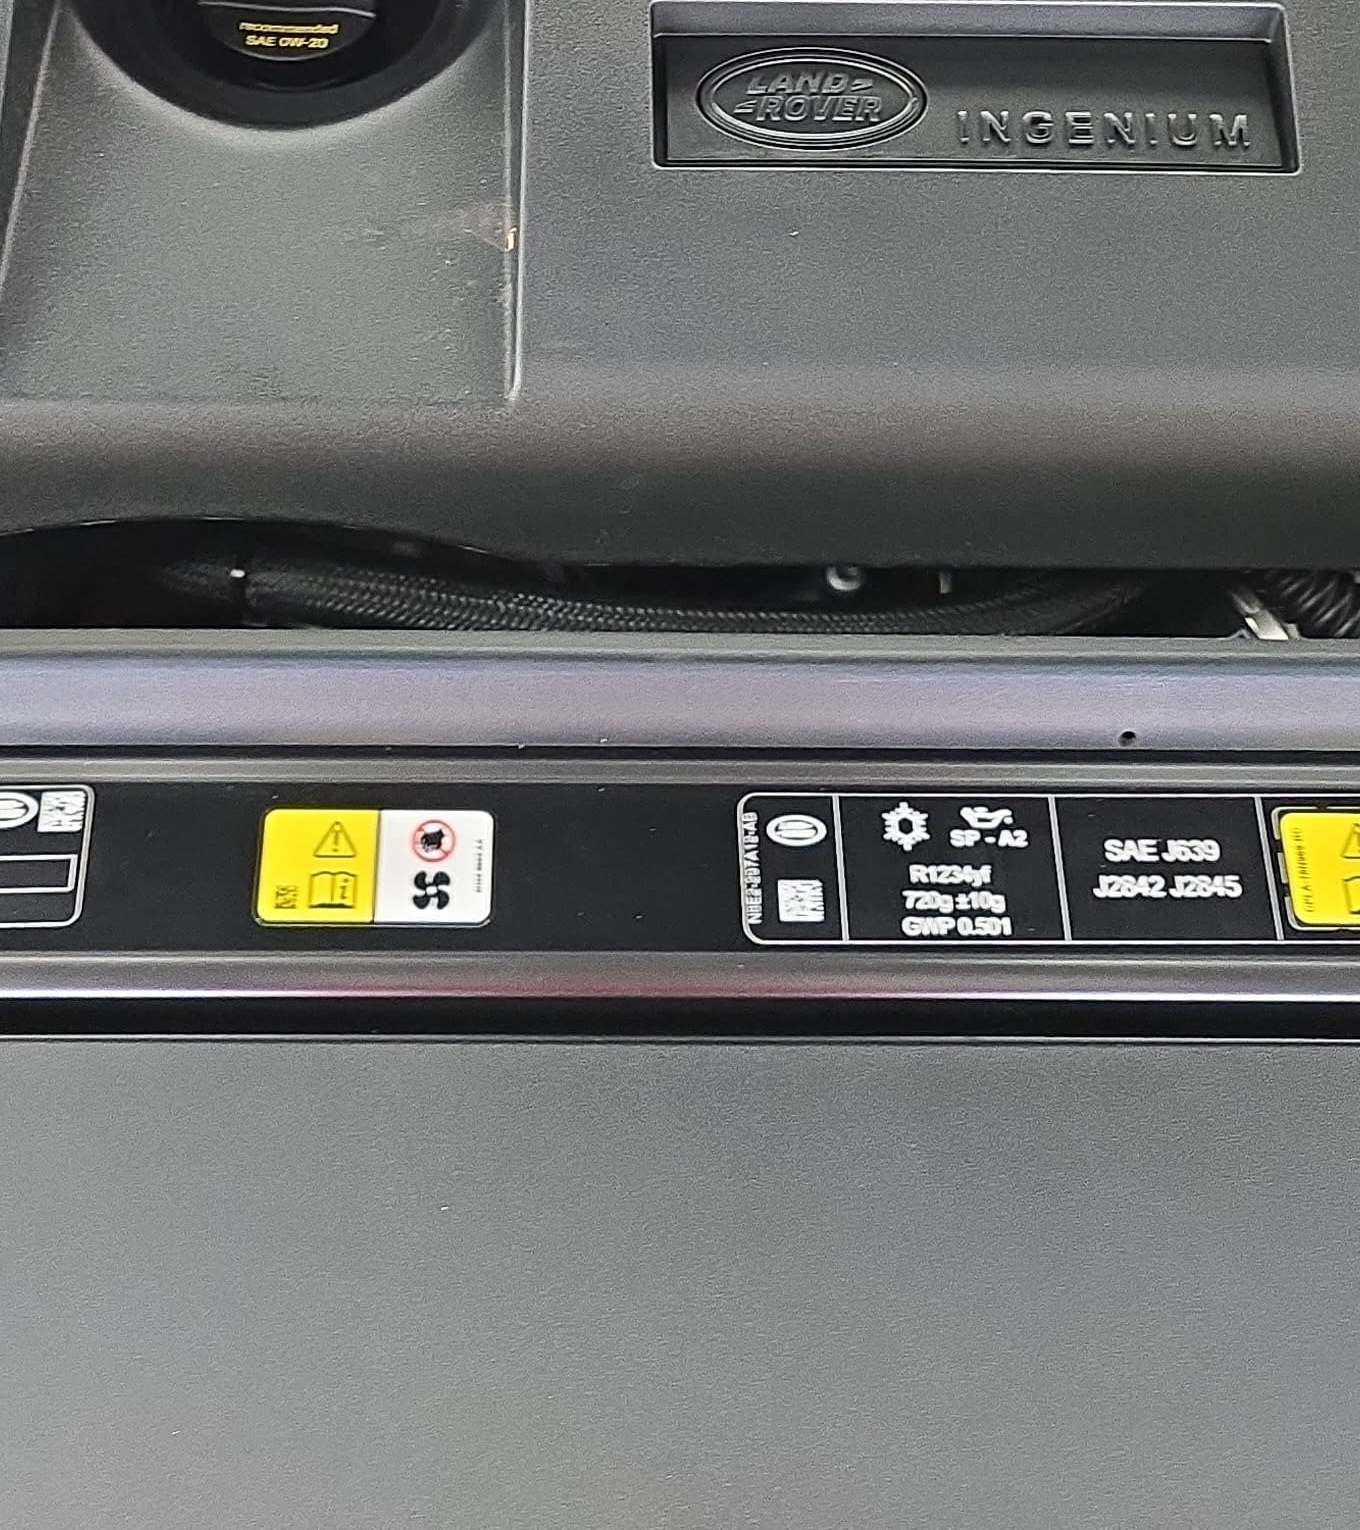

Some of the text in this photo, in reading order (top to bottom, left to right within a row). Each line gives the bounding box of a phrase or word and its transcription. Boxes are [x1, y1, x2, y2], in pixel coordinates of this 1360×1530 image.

[239, 22, 339, 35] recommended
[245, 35, 329, 49] SAE 0W-20
[746, 72, 849, 95] LAND
[756, 95, 882, 122] ROVER
[956, 110, 1252, 148] INGENIUM
[949, 829, 981, 848] SP
[997, 829, 1029, 848] A2
[1103, 838, 1221, 863] SAE J639
[908, 864, 992, 887] R1234yf
[1092, 874, 1243, 898] J2842 J2845
[901, 890, 1007, 914] 720g ±10g
[901, 916, 1013, 936] GWP 0.501
